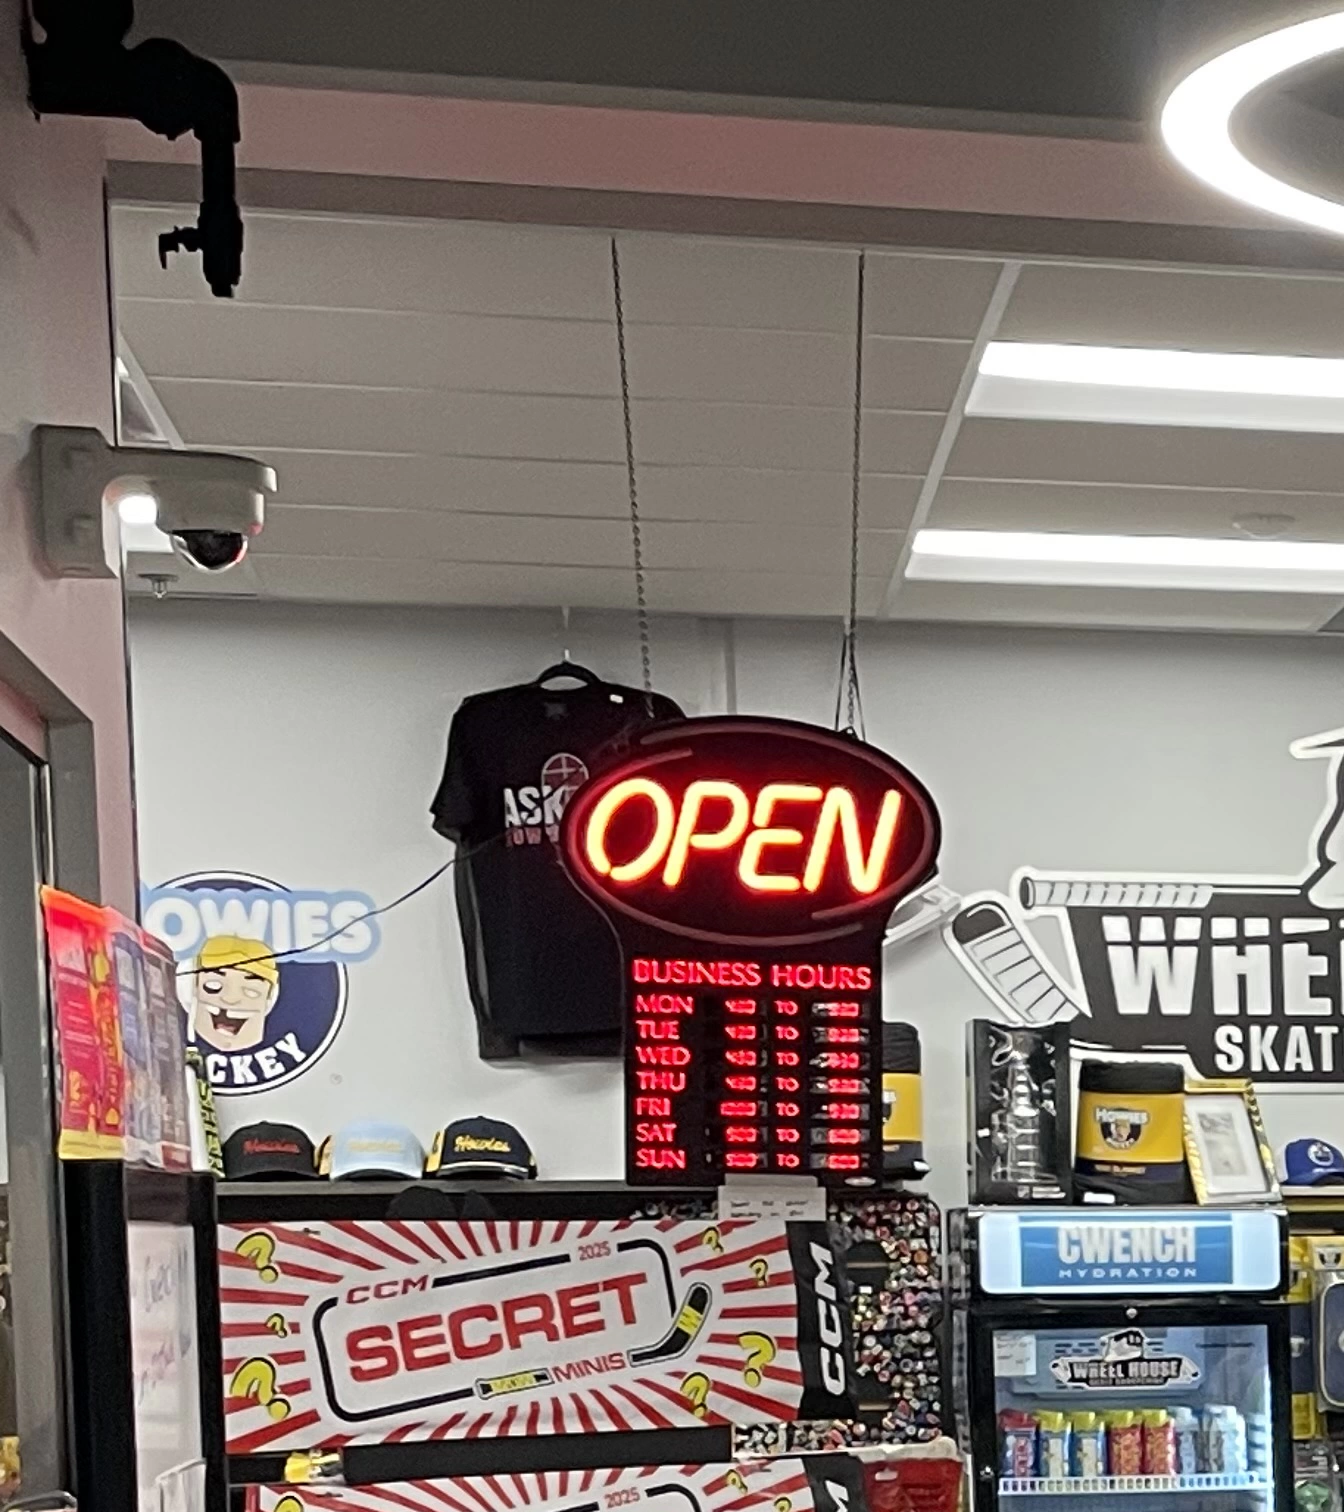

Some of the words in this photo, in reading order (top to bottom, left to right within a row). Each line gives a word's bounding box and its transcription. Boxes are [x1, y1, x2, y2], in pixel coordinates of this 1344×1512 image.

[587, 778, 902, 894] OPEN
[143, 896, 373, 956] OWIES
[633, 959, 762, 987] BUSINESS
[771, 963, 873, 990] HOURS
[635, 994, 694, 1015] MON
[775, 1000, 798, 1015] TO
[635, 1020, 680, 1040] TUE
[776, 1026, 800, 1040] TO
[207, 1033, 307, 1085] CKEY
[635, 1046, 691, 1066] WED
[776, 1052, 800, 1067] TO
[635, 1071, 687, 1091] THU
[776, 1077, 800, 1092] TO
[635, 1097, 671, 1117] FRI
[776, 1102, 800, 1117] TO
[635, 1123, 677, 1142] SAT
[776, 1129, 800, 1143] TO
[635, 1149, 686, 1169] SUN
[776, 1153, 800, 1168] TO
[577, 1241, 611, 1262] 2025
[1056, 1226, 1196, 1264] CWENCH
[1058, 1267, 1197, 1279] HYDRATION
[346, 1274, 430, 1305] CCM
[344, 1271, 650, 1383] SECRET
[808, 1239, 849, 1397] CCM
[551, 1350, 628, 1383] MINIS
[1128, 1361, 1180, 1379] HOUSE
[604, 1486, 641, 1510] 2025
